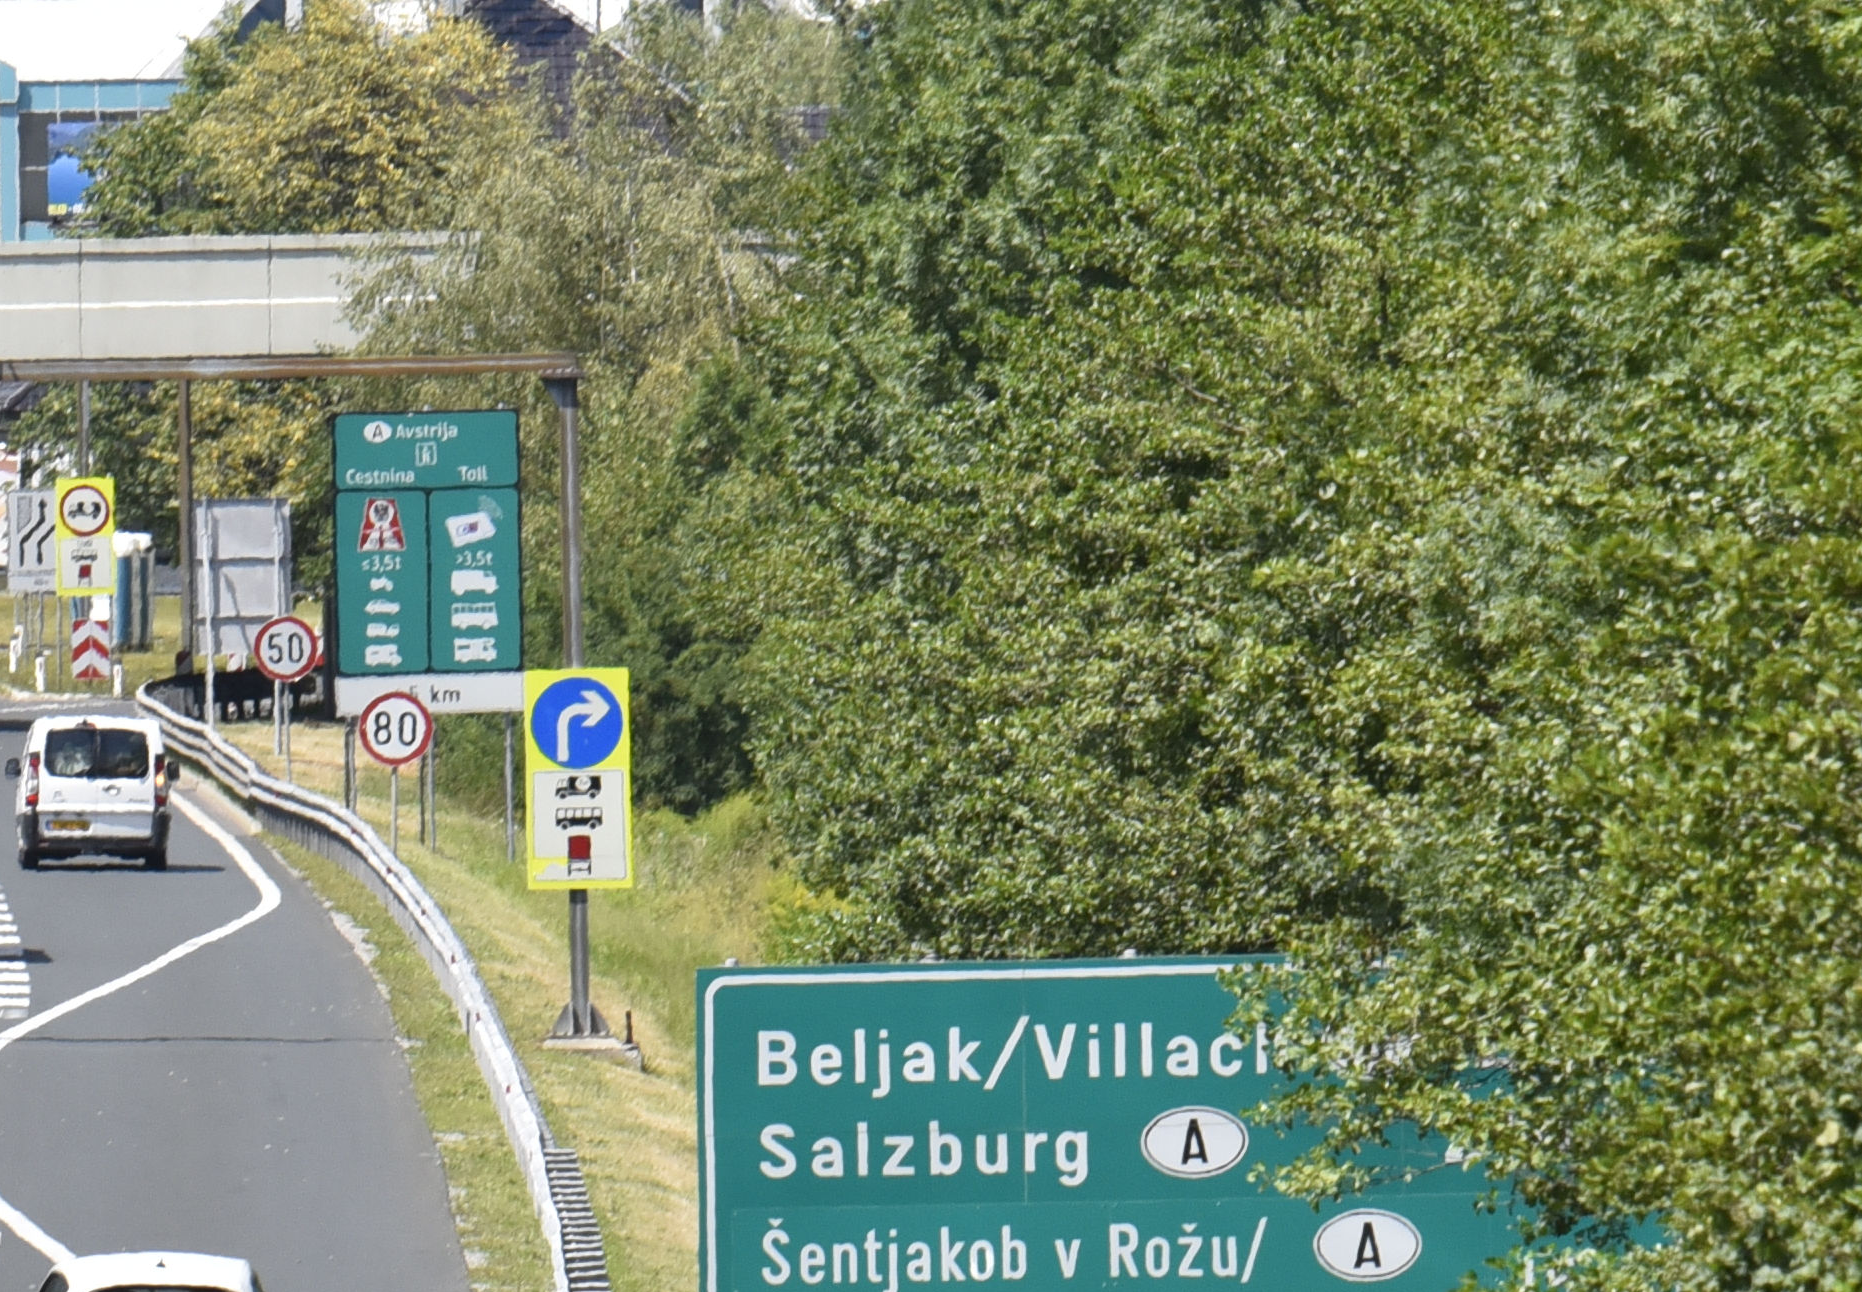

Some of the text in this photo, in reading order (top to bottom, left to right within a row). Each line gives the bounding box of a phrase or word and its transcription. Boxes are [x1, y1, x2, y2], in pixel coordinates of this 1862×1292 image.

[371, 422, 458, 441] A Avstrija
[345, 465, 488, 485] Cestnina Toll
[268, 632, 304, 664] 50
[430, 684, 461, 704] km
[373, 711, 417, 746] 80
[759, 1120, 1091, 1186] Salzburg
[1180, 1118, 1209, 1164] A
[1054, 1237, 1081, 1279] v
[1109, 1215, 1269, 1284] Rožu/
[1353, 1221, 1382, 1270] A
